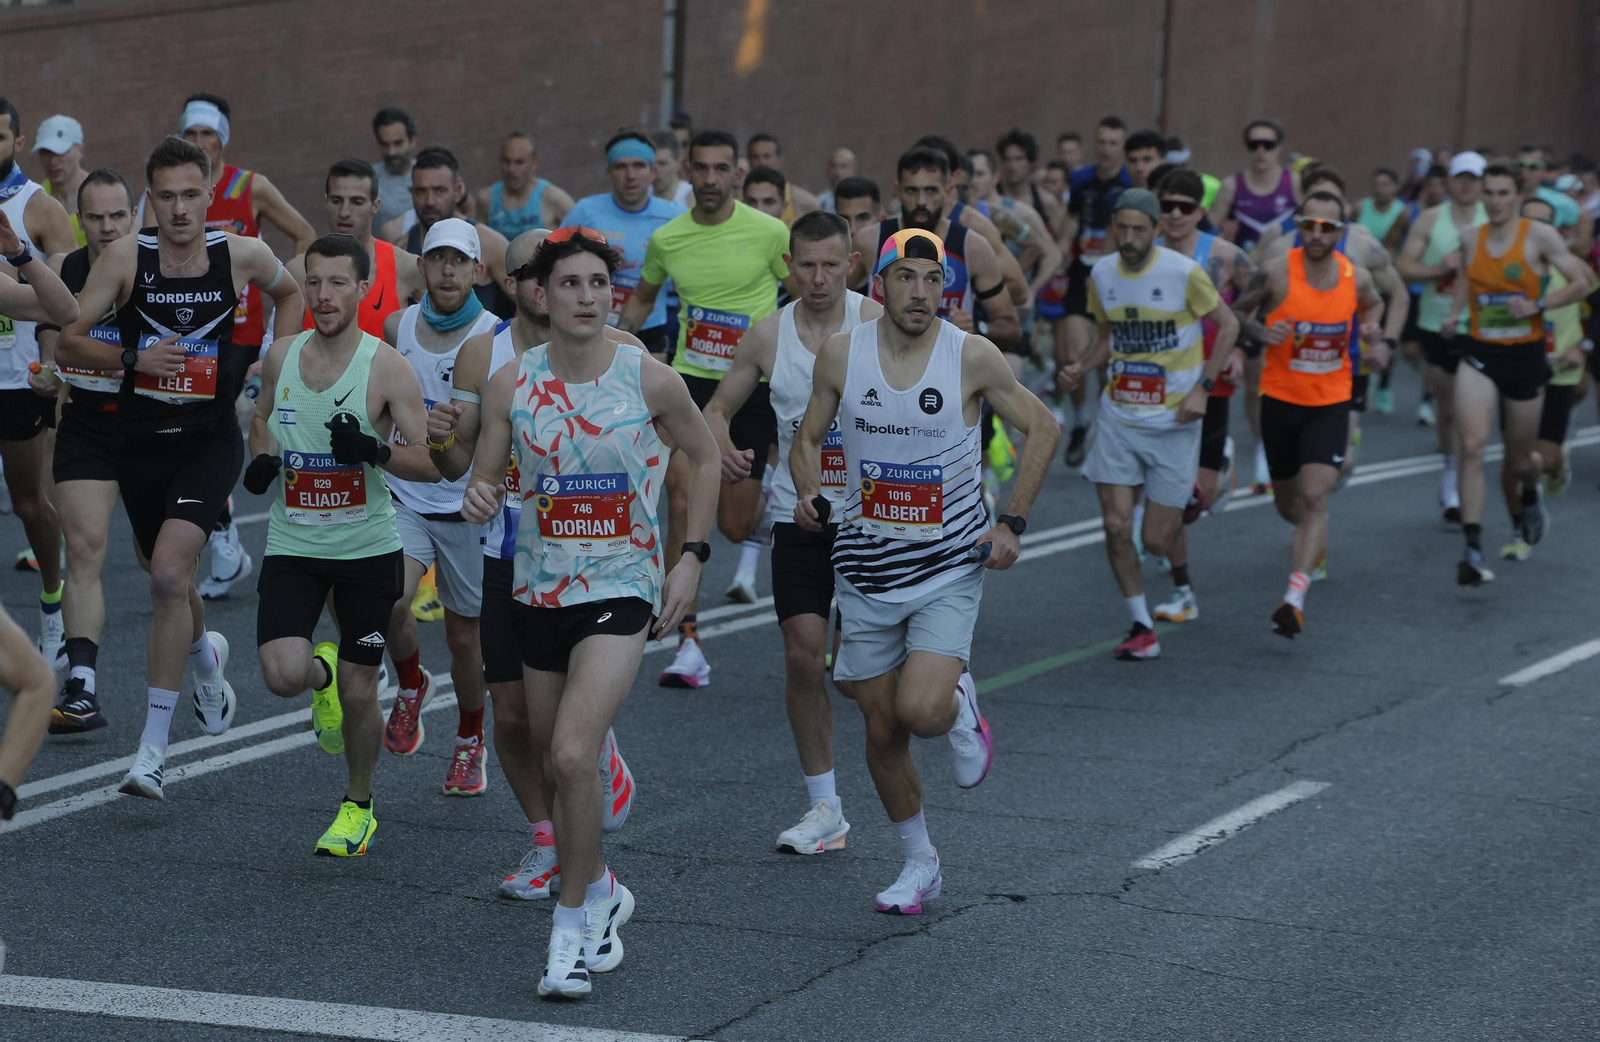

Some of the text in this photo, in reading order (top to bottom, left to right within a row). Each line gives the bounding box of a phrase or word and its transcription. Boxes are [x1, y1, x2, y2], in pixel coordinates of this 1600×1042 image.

[146, 291, 222, 304] BORDEAUX
[706, 312, 742, 326] ZURICH
[88, 329, 120, 341] URICH
[707, 329, 723, 340] 724
[158, 377, 193, 393] LELE
[855, 417, 910, 436] Ripollet
[910, 426, 947, 439] Triatló
[309, 457, 347, 467] ZURI
[827, 456, 844, 467] 725
[886, 468, 933, 480] ZURICH
[314, 478, 332, 489] 829
[565, 478, 617, 491] ZURICH
[299, 490, 351, 508] ELIADZ
[887, 489, 912, 502] 1016
[572, 503, 593, 515] 746
[872, 502, 930, 522] ALBERT
[551, 519, 616, 536] DORIAN
[356, 640, 371, 648] NIKE
